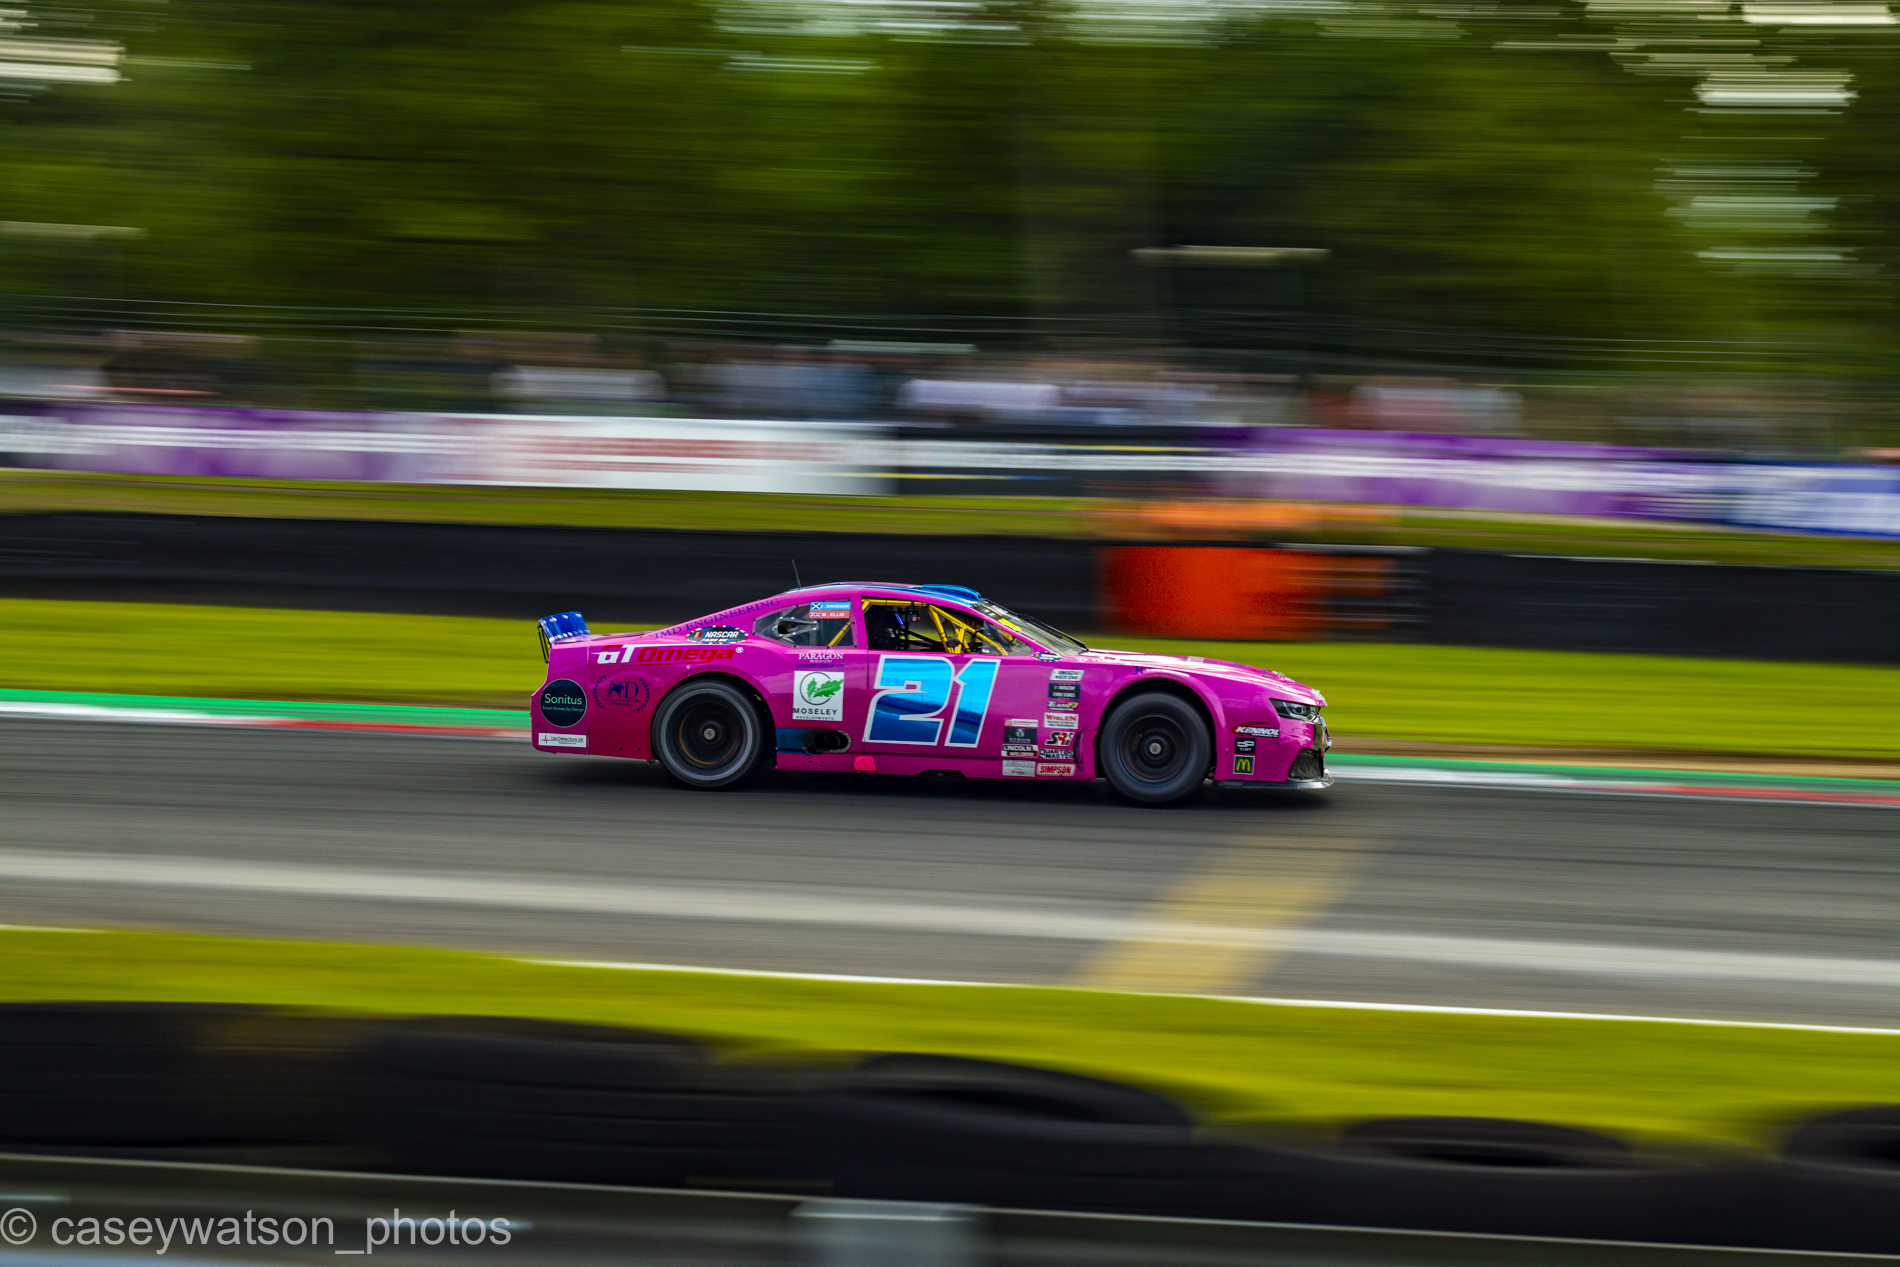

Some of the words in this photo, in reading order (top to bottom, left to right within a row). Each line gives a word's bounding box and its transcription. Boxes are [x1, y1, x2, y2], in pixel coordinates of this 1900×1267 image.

[685, 598, 780, 630] ENGINEERING
[544, 693, 582, 705] Sonitus
[862, 654, 1001, 748] 21
[1235, 726, 1279, 735] KENNOL
[1040, 765, 1072, 774] SIMPSON
